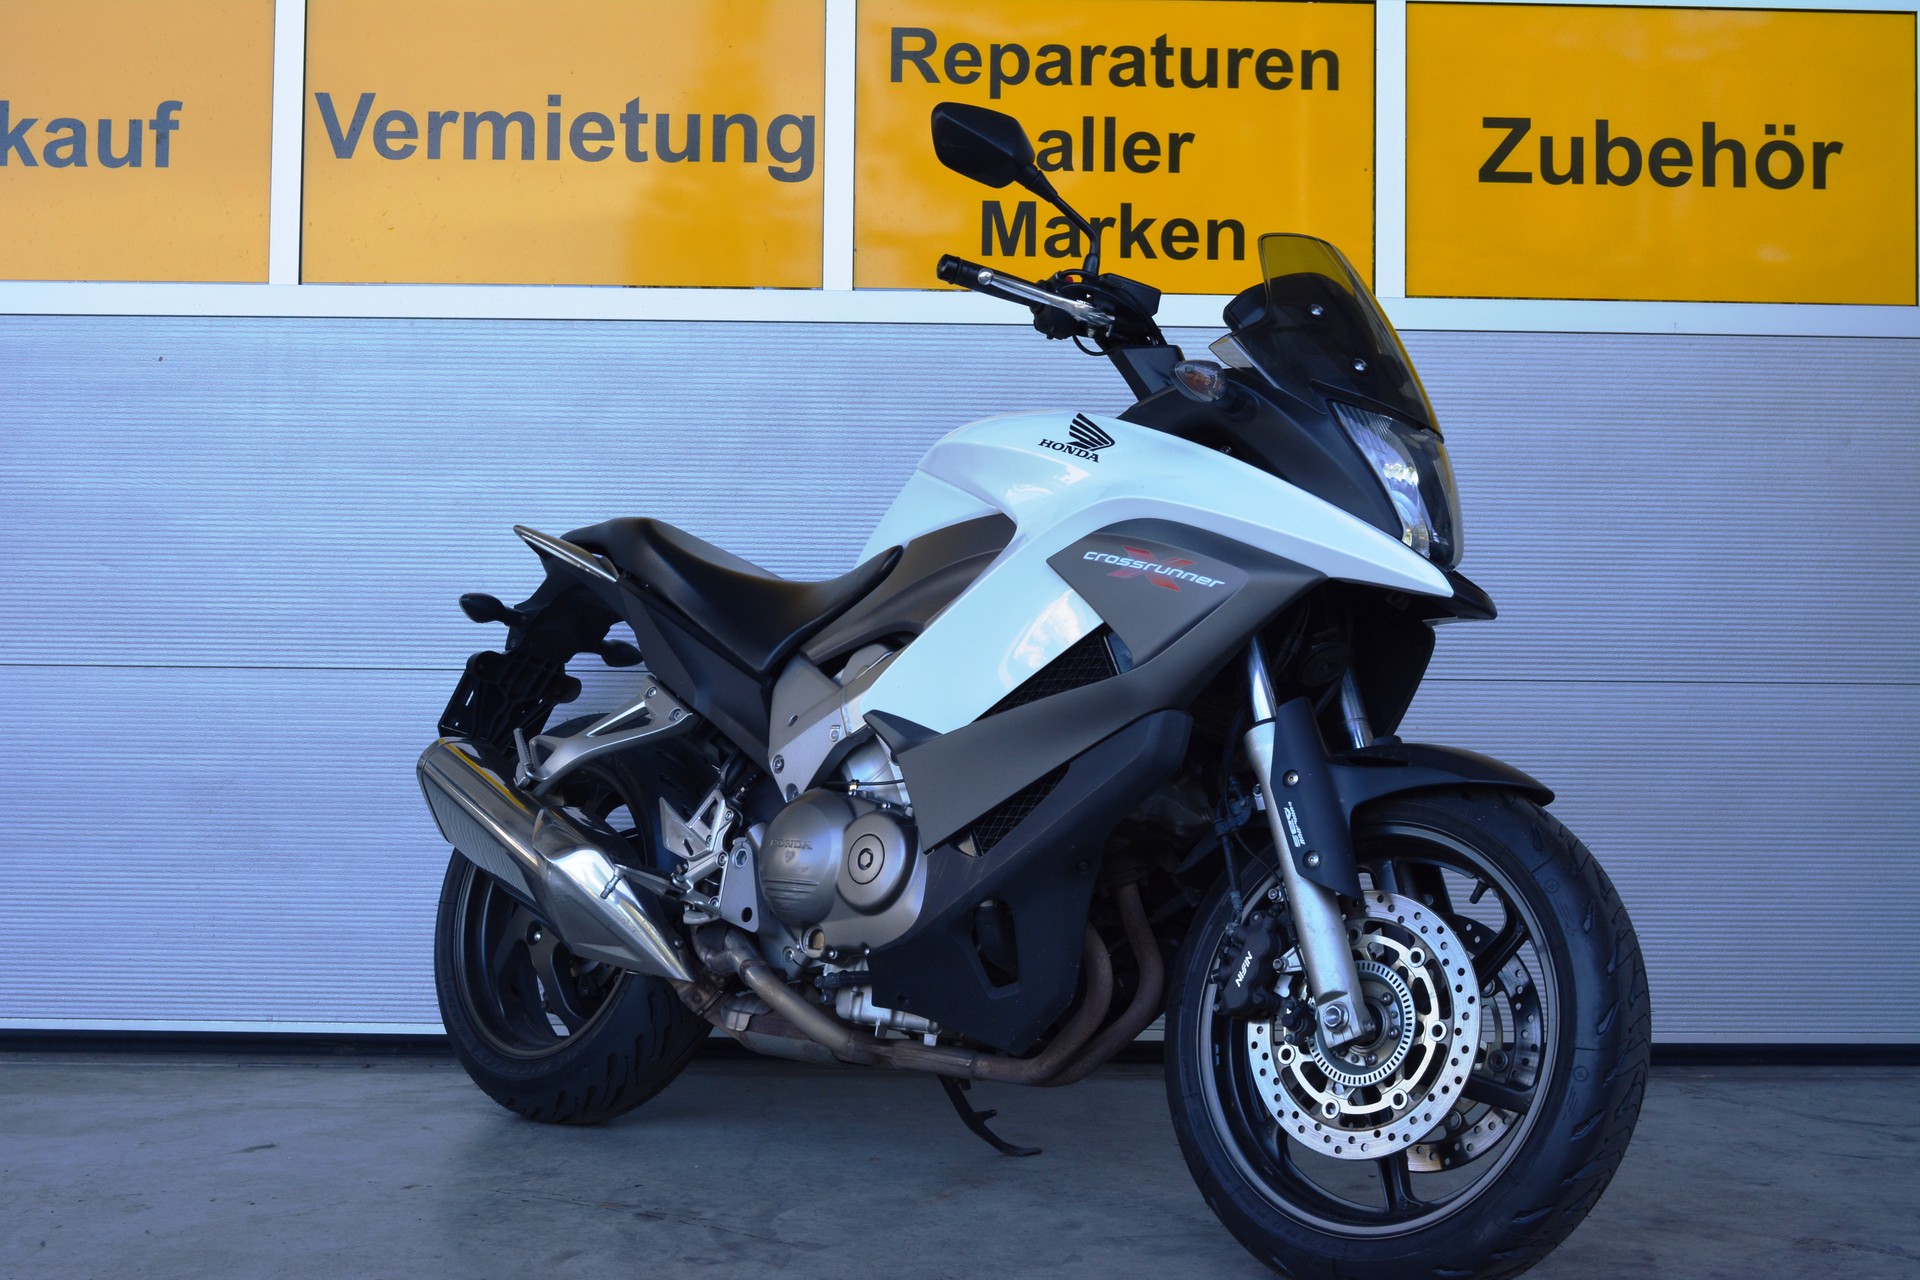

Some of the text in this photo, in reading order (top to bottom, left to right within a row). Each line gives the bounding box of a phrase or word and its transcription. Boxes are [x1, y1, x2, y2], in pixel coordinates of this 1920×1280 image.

[890, 27, 1340, 99] Reparaturen
[314, 93, 815, 183] Vermietung
[1036, 116, 1196, 174] aller
[1478, 116, 1844, 190] Zubehör
[981, 200, 1245, 261] Marken
[1038, 438, 1099, 463] HONDA
[1083, 551, 1226, 588] crossrunner
